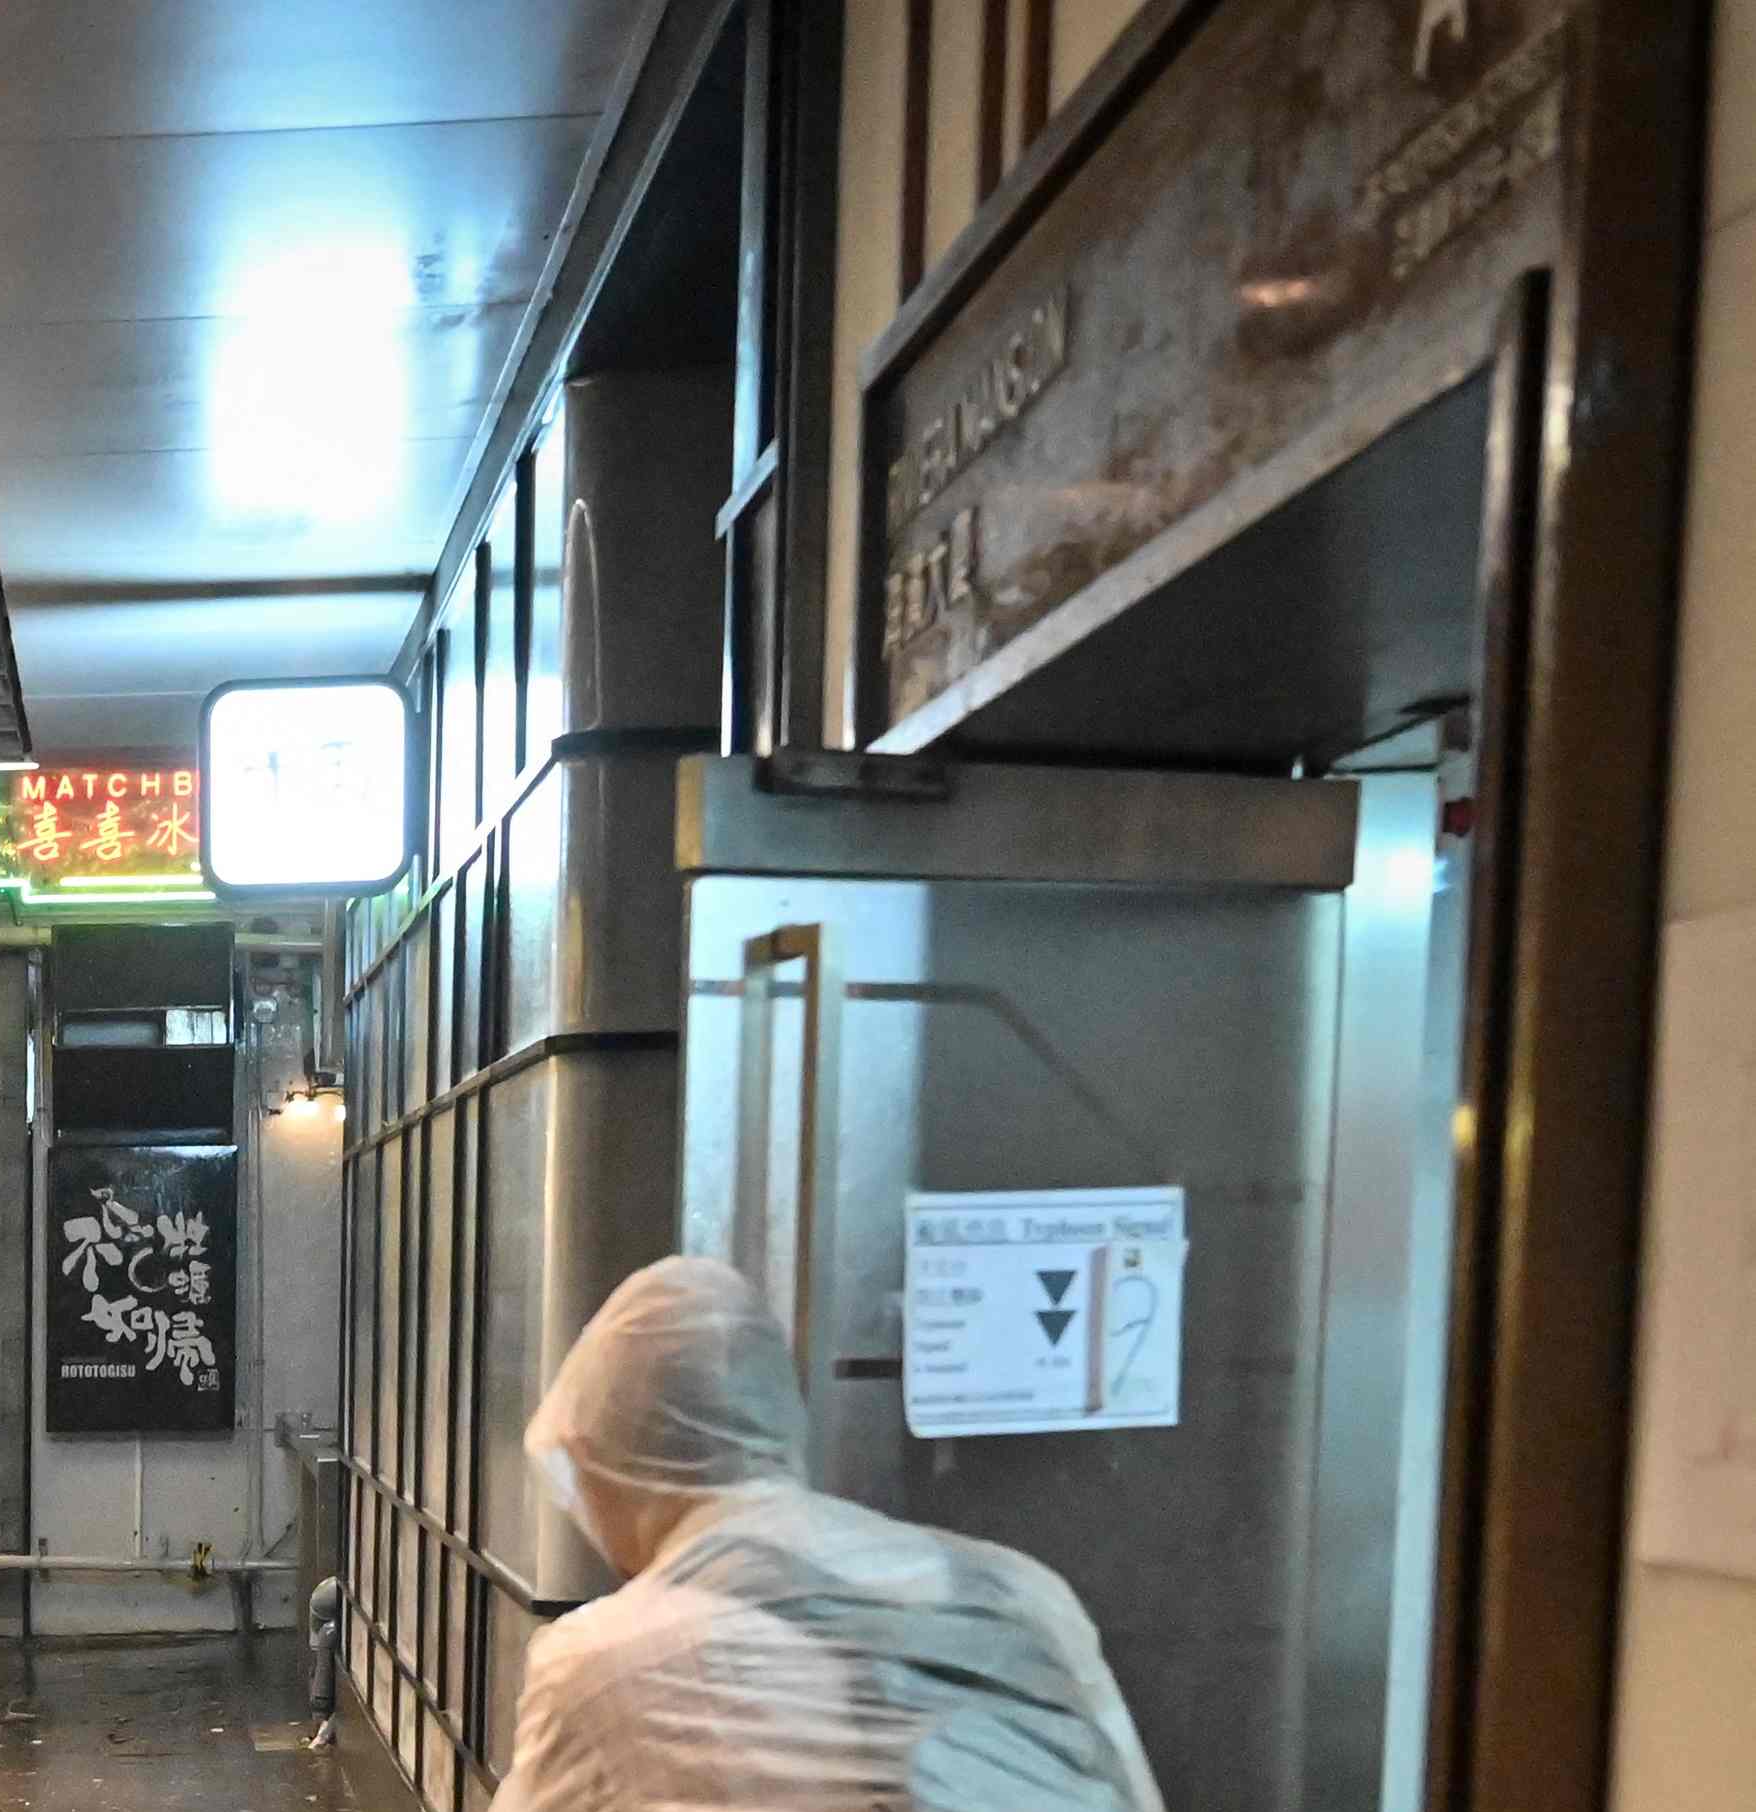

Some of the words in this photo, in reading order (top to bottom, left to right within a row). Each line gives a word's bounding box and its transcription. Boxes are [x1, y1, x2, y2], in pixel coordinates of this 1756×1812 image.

[17, 800, 200, 861] 喜喜冰
[61, 1364, 136, 1378] HOTOTOGISU
